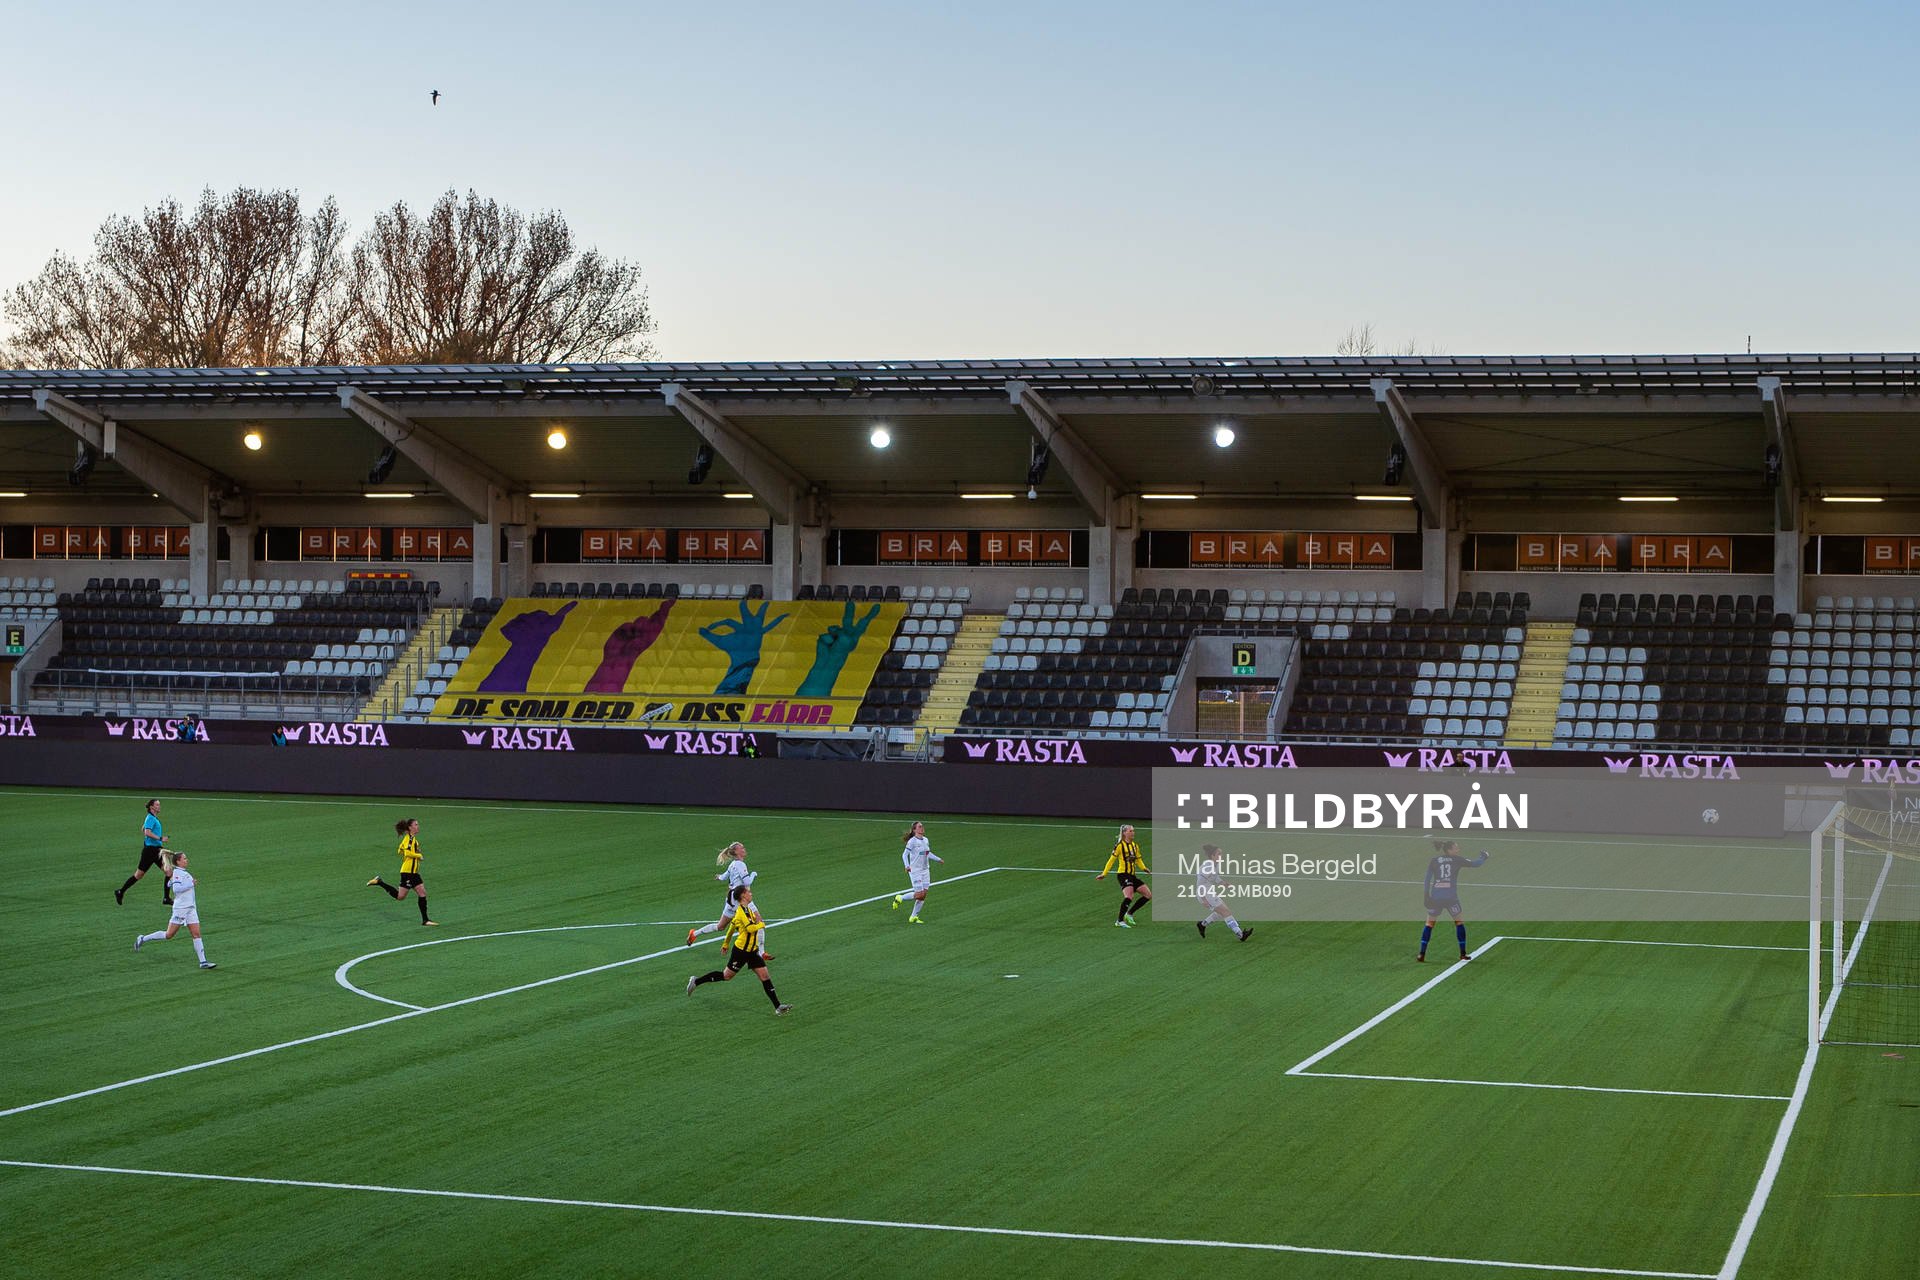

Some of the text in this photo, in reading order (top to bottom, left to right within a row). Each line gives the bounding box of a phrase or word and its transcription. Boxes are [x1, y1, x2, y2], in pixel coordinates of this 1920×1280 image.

[589, 537, 663, 551] BRA
[685, 537, 758, 551] BRA
[887, 539, 964, 553] BRA
[987, 539, 1065, 553] BRA
[1199, 540, 1279, 555] BRA
[1305, 541, 1387, 556] BRA
[1527, 543, 1613, 558] BRA
[1639, 544, 1725, 559] BRA
[10, 631, 20, 645] E
[1237, 650, 1251, 666] D
[447, 698, 834, 724] DE SOM GER OSS FÄRG
[131, 718, 210, 742] RASA
[307, 722, 390, 747] RASTA
[490, 727, 575, 751] RASTA
[995, 739, 1088, 765] RASTA
[1203, 743, 1298, 769] RASTA
[1638, 753, 1741, 780] RASTA
[1439, 863, 1451, 878] 13
